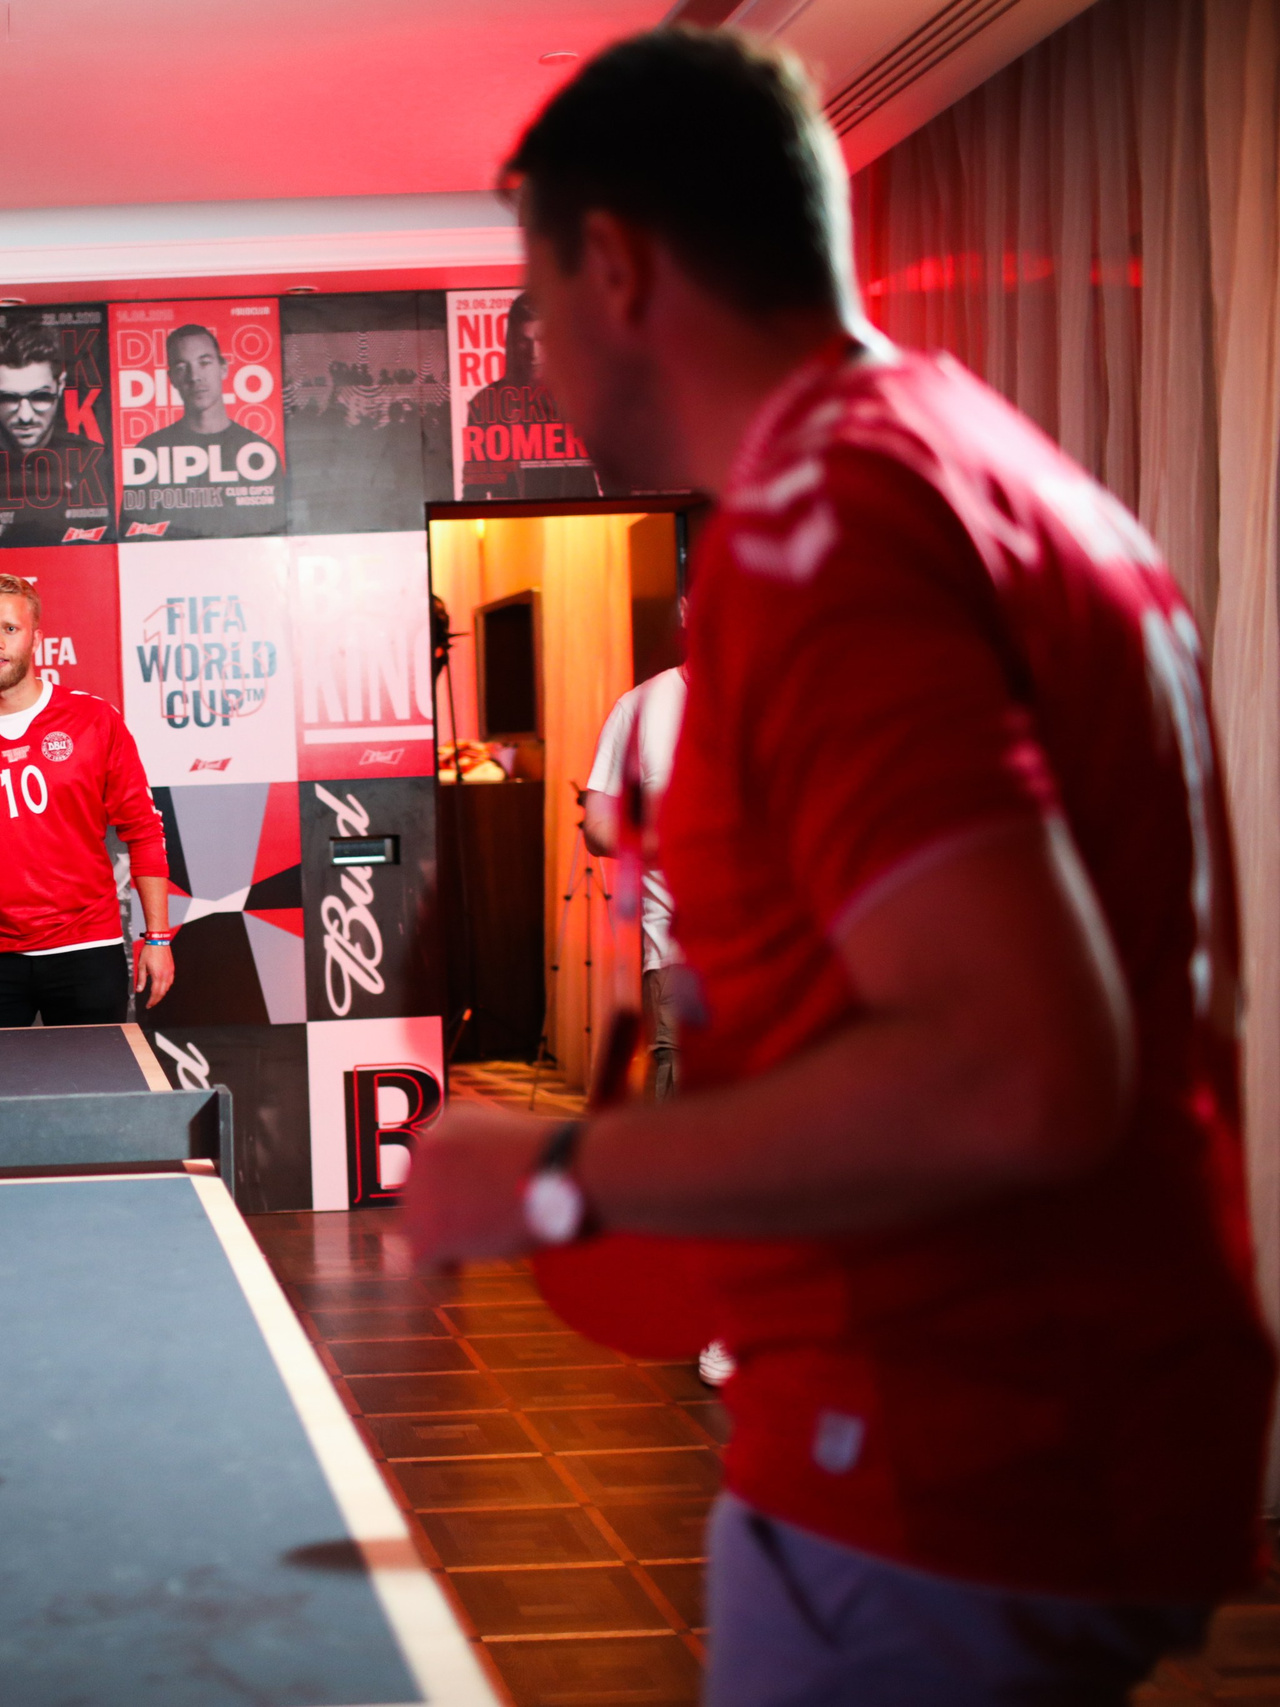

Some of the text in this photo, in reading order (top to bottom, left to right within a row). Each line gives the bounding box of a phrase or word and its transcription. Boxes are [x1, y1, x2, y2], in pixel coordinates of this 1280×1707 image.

[118, 364, 275, 409] DIO
[121, 441, 277, 487] DIPLO
[123, 487, 223, 511] DJ POLITIK
[166, 595, 247, 635] FIFA
[33, 636, 77, 667] IFA
[136, 641, 278, 683] WORLD
[0, 764, 48, 819] 10
